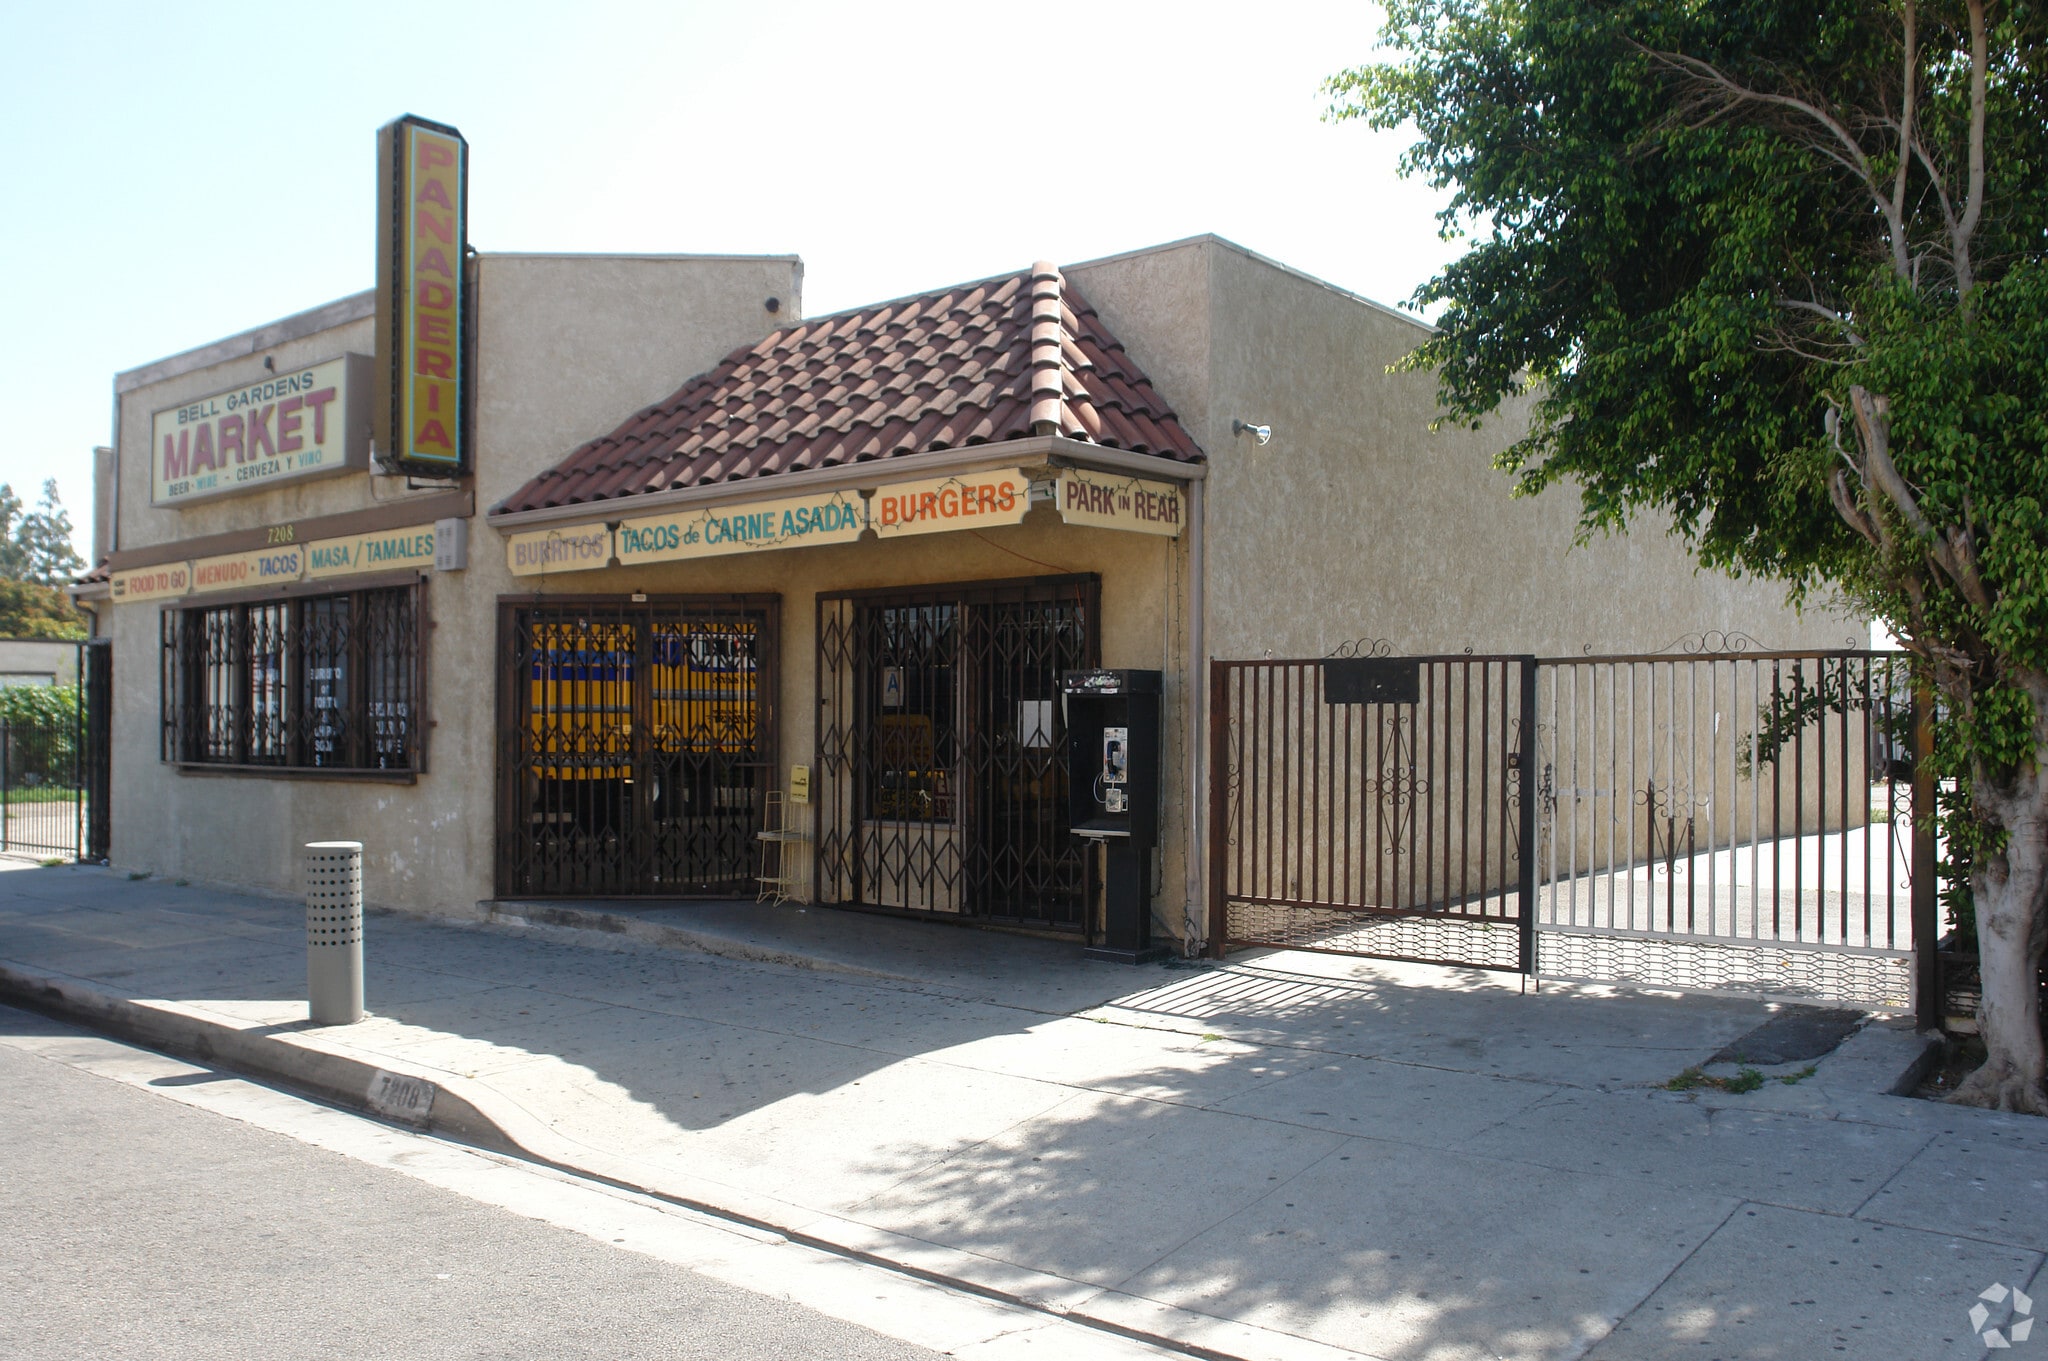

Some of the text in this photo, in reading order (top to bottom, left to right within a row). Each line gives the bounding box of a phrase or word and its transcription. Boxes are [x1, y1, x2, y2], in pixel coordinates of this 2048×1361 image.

[417, 142, 454, 449] PANADERIA
[178, 372, 313, 425] BELL GARDENS
[163, 387, 335, 481] MARKET
[169, 481, 190, 497] BEER
[196, 474, 218, 490] WINE
[237, 460, 280, 482] CERVEZA
[287, 457, 292, 470] Y
[299, 450, 322, 467] VINO
[881, 481, 1016, 526] BURGERS
[1066, 481, 1180, 524] PARK IN REAR
[267, 525, 294, 544] 7208
[620, 502, 858, 554] TACOS de CARNE ASADA
[196, 553, 297, 585] MENUDO TACOS
[311, 541, 349, 570] MASA
[366, 534, 435, 563] TAMALES
[515, 534, 604, 567] BURRITOS
[129, 576, 154, 594] FOOD
[155, 573, 169, 590] TO
[170, 571, 186, 588] GO
[888, 673, 899, 692] A
